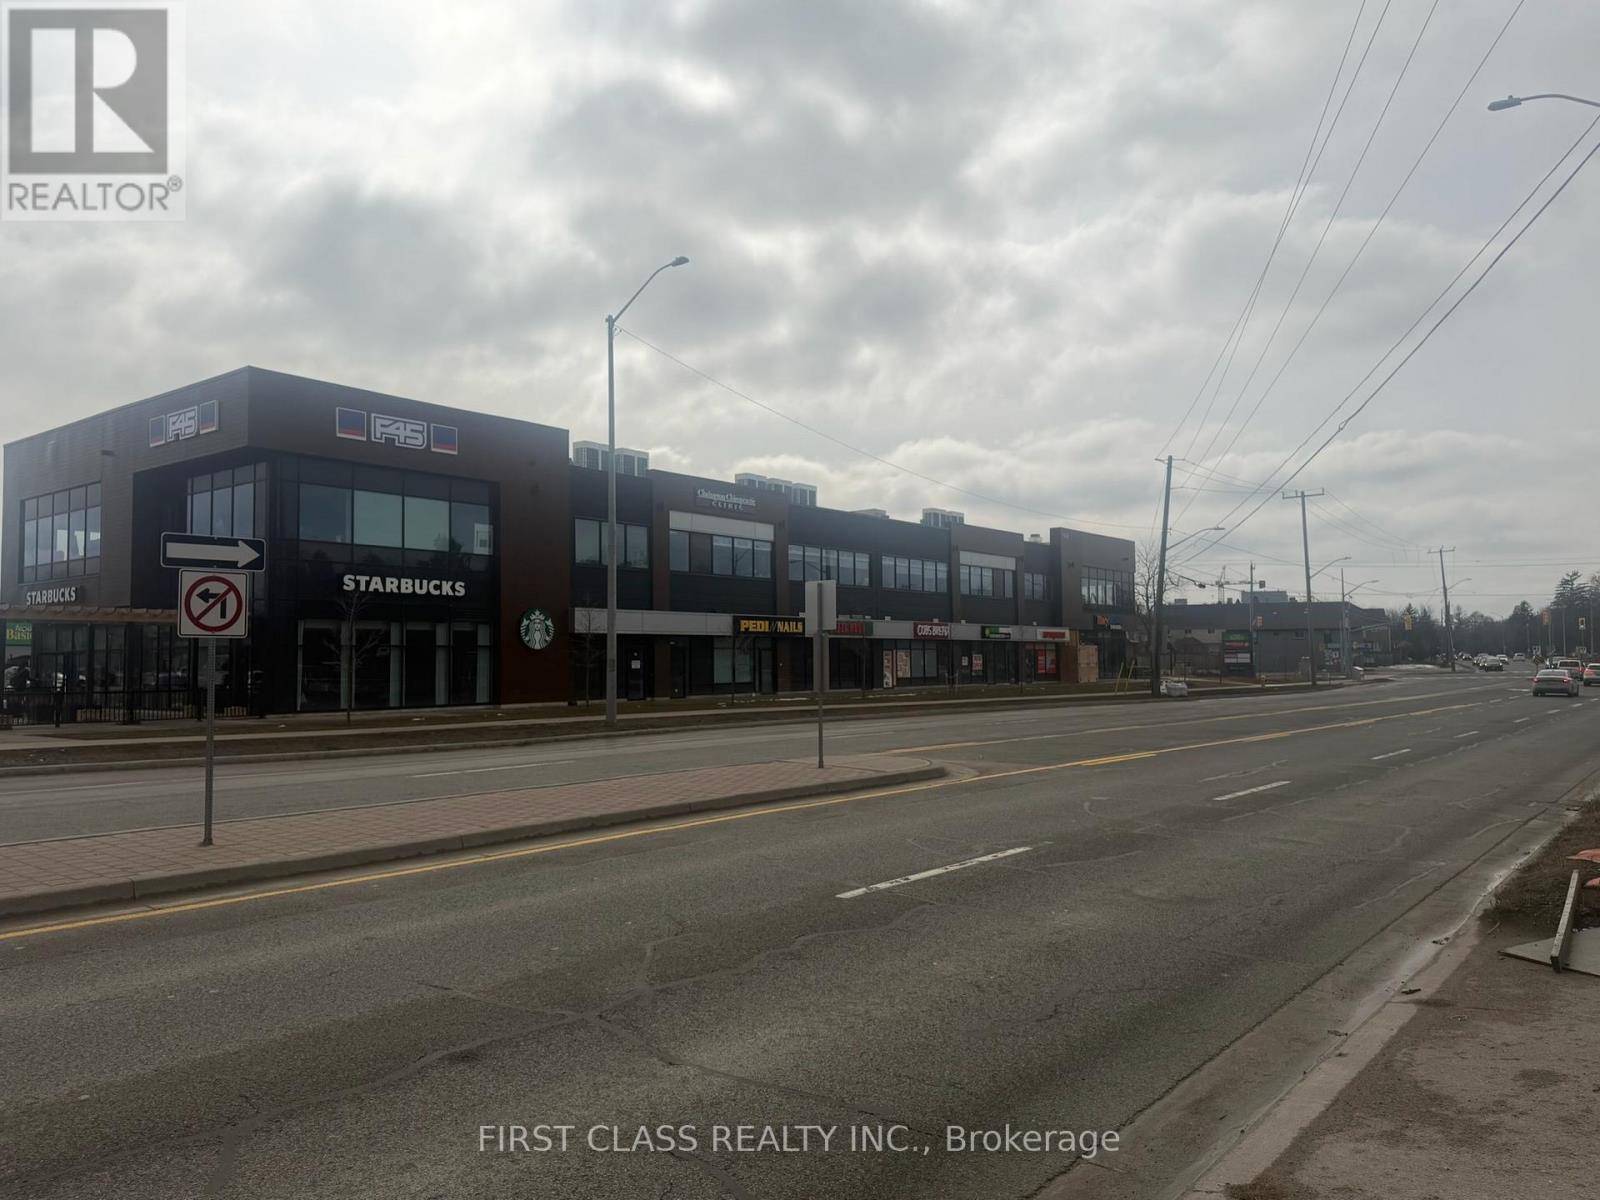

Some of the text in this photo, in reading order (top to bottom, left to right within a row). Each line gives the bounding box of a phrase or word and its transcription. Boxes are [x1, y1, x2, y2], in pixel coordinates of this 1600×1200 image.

[168, 408, 197, 439] F45
[374, 416, 425, 447] F45
[26, 586, 76, 606] STARBUCKS
[343, 574, 466, 597] STARBUCKS
[740, 619, 769, 632] PEDI
[776, 620, 803, 633] NAILS
